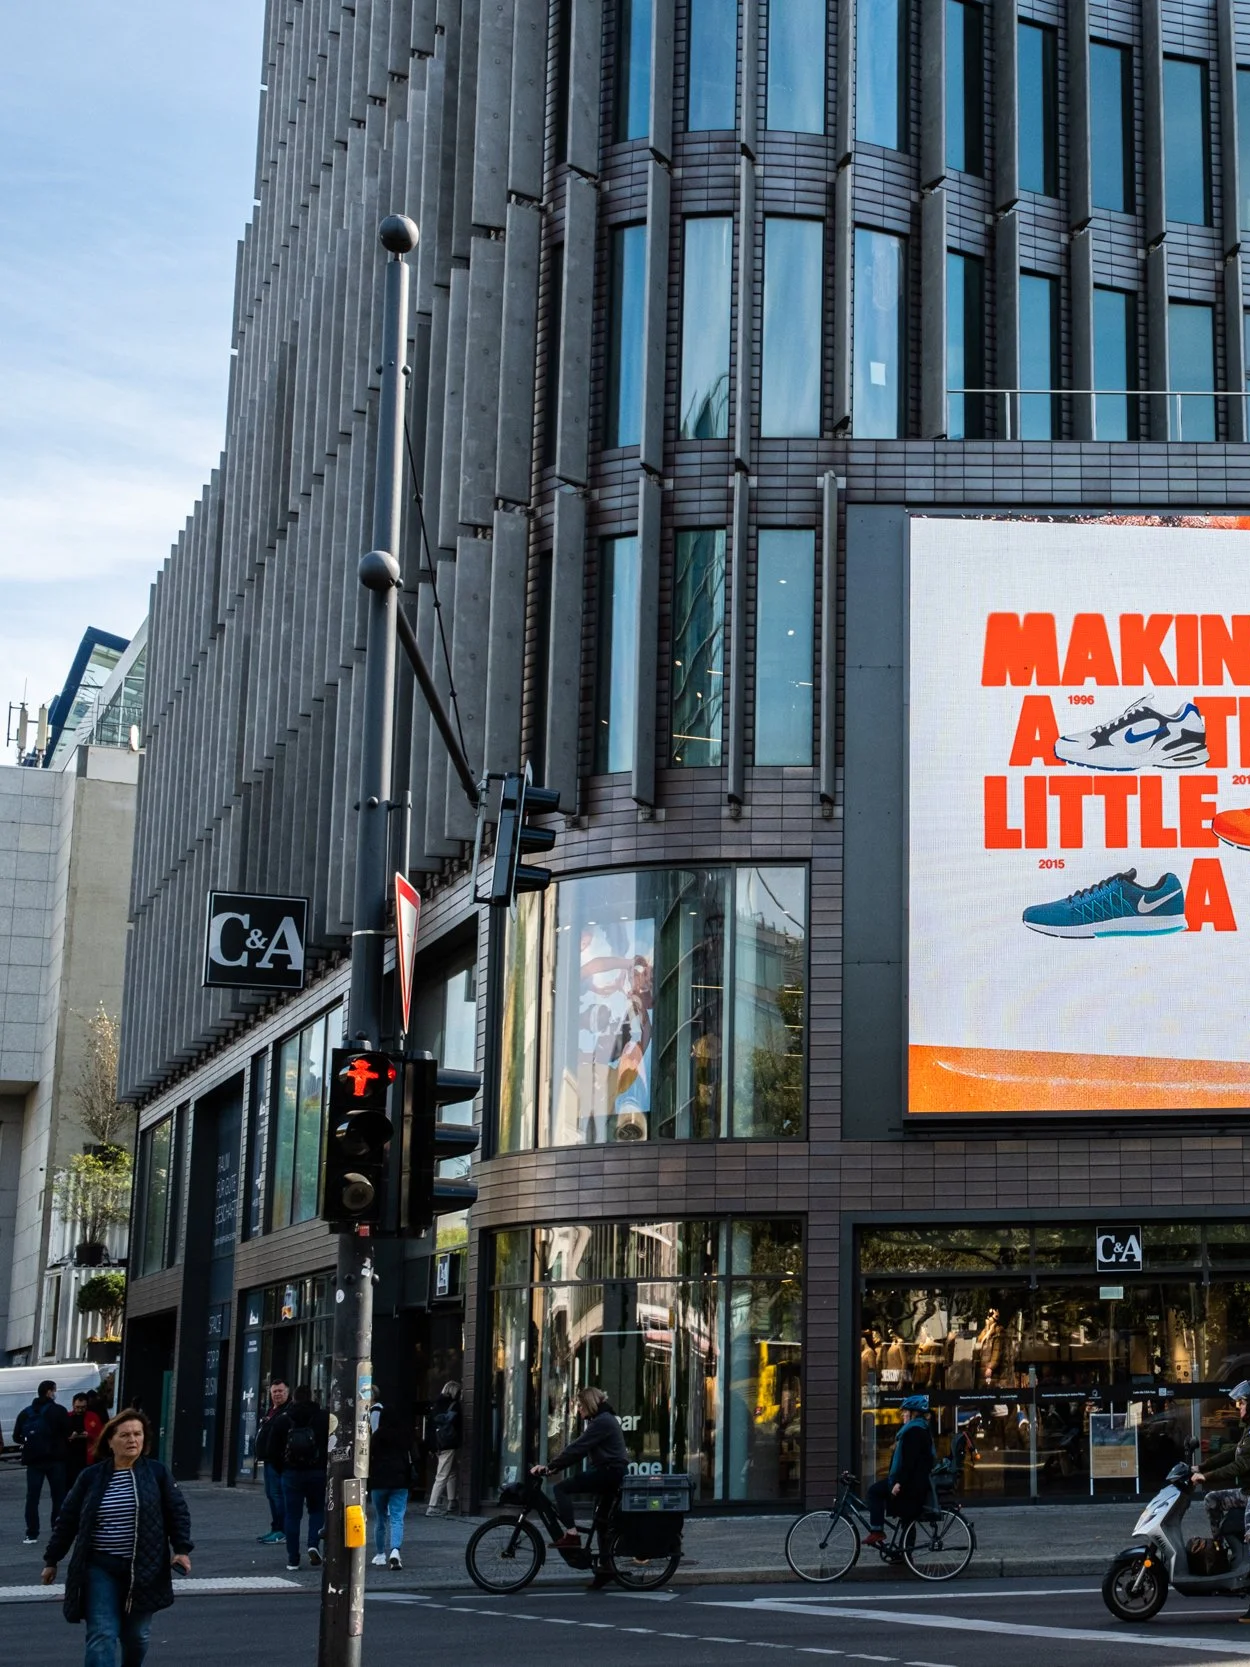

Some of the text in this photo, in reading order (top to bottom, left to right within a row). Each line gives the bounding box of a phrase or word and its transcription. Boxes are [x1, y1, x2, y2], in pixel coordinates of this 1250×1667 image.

[1067, 694, 1095, 705] 1996
[1009, 695, 1066, 766] A
[984, 775, 1219, 849] LITTLE
[1038, 859, 1066, 870] 2015
[1184, 858, 1238, 932] A
[210, 911, 304, 970] C&A
[1097, 1234, 1142, 1262] C&A
